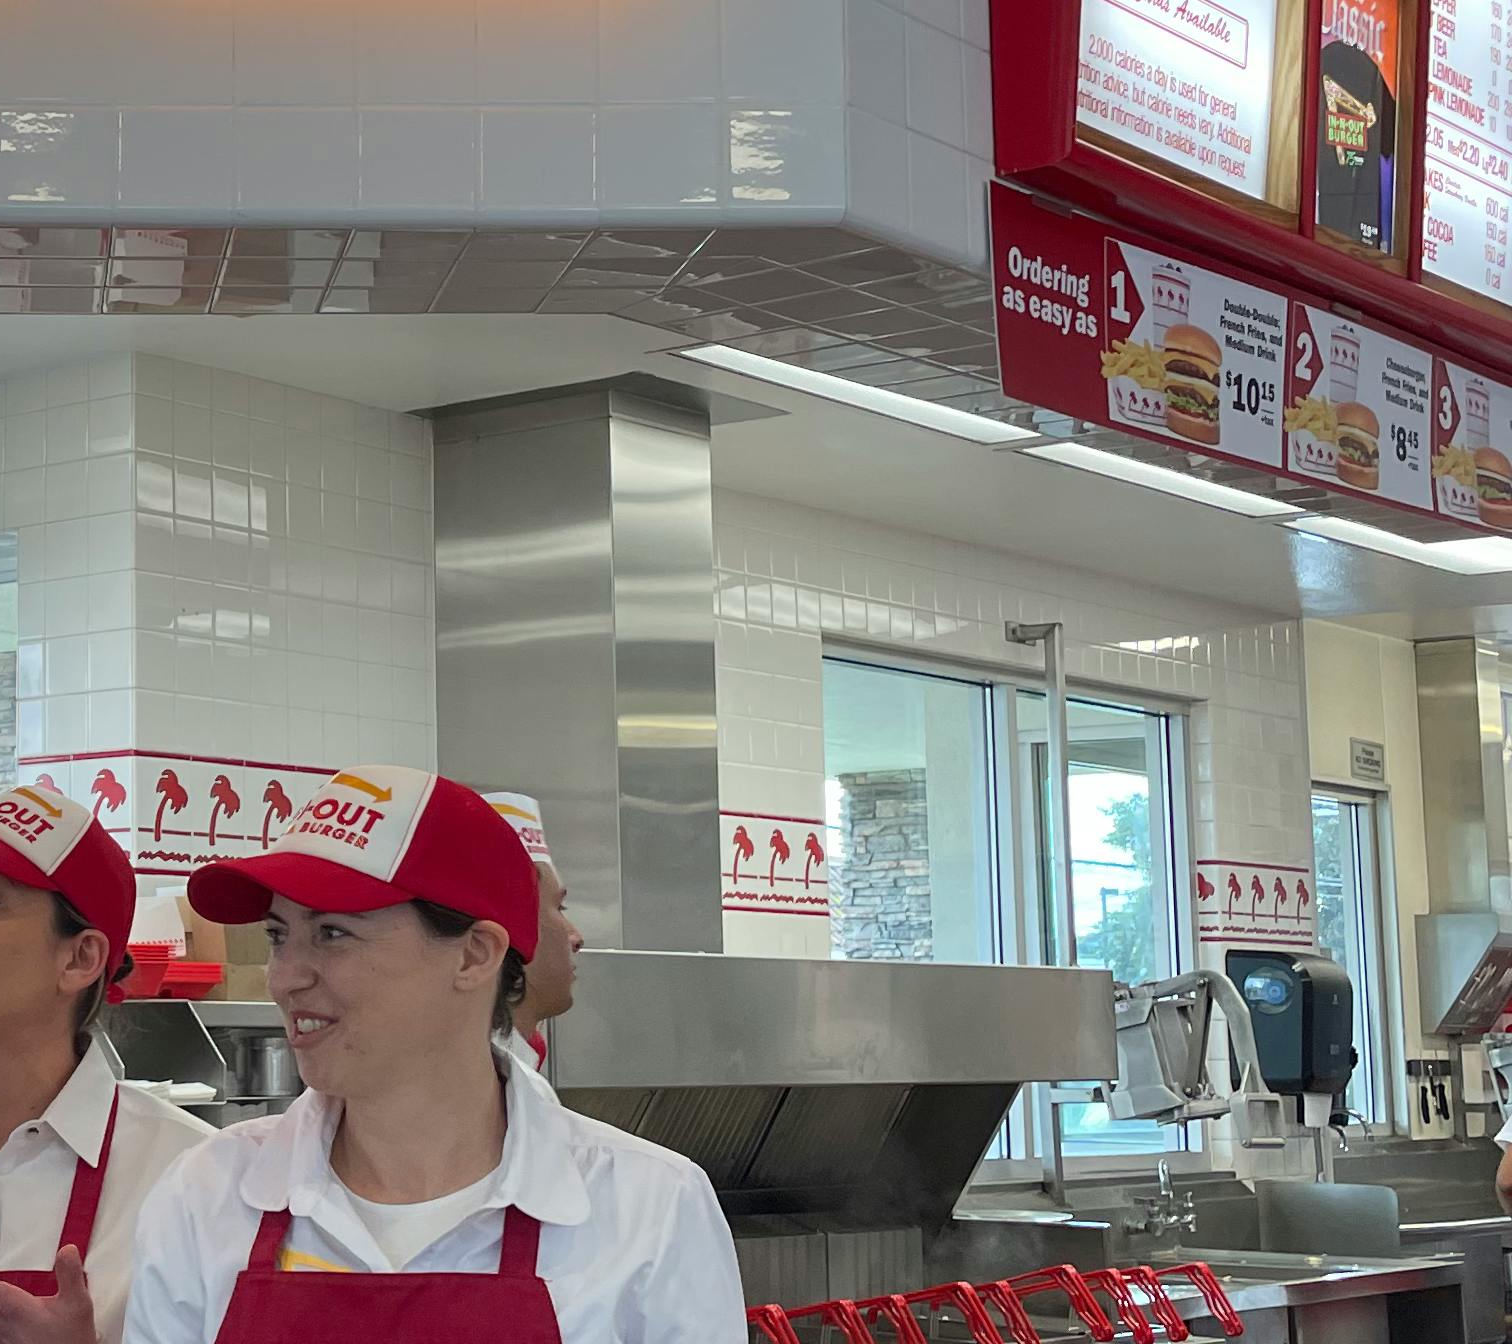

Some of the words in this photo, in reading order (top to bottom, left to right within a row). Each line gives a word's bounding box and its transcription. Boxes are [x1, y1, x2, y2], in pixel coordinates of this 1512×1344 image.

[1173, 0, 1231, 44] Available
[1115, 50, 1146, 78] calories
[1146, 65, 1154, 82] a
[1154, 65, 1168, 93] day
[1169, 71, 1177, 93] is
[1178, 79, 1196, 103] used
[1198, 85, 1209, 107] for
[1210, 94, 1238, 121] general
[1432, 58, 1472, 97] LEMONADE
[1132, 82, 1146, 106] but
[1147, 92, 1173, 119] calorie
[1174, 105, 1197, 131] needs
[1217, 122, 1253, 154] Additional
[1446, 90, 1485, 127] LEMONADE
[1110, 103, 1155, 138] information
[1156, 122, 1164, 143] is
[1164, 129, 1196, 157] available
[1198, 145, 1217, 166] upon
[1328, 127, 1364, 147] BURGER
[1426, 123, 1444, 149] 2.05
[1427, 216, 1454, 246] COCOA
[1008, 246, 1090, 308] Ordering
[1111, 270, 1131, 324] 1
[1002, 285, 1026, 313] as
[1029, 295, 1073, 335] easy
[1075, 311, 1098, 338] as
[1220, 315, 1245, 335] French
[1270, 335, 1283, 347] and
[1225, 334, 1255, 355] Medium
[1257, 345, 1276, 362] Drink
[1295, 332, 1313, 381] 2
[1438, 385, 1453, 430] 3
[298, 821, 369, 850] BURGER
